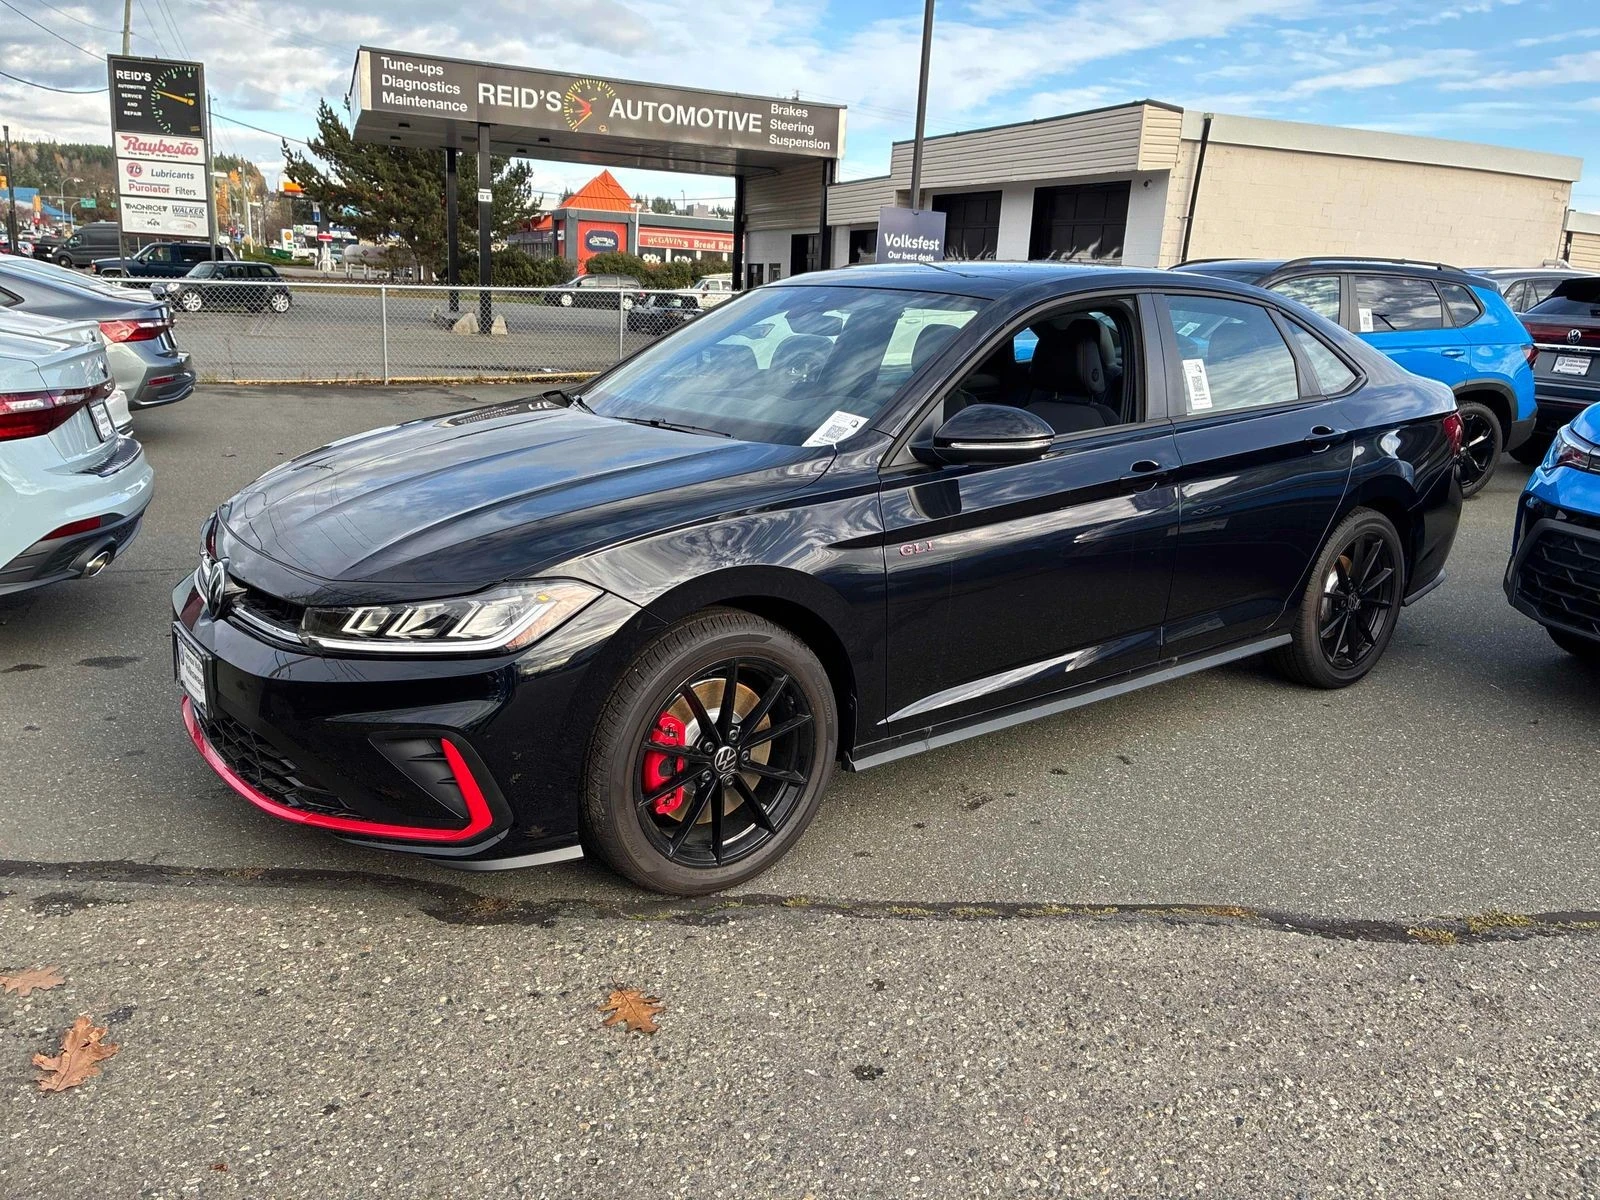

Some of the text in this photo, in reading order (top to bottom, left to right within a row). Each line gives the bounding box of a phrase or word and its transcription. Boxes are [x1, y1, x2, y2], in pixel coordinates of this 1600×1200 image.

[380, 56, 444, 76] Tune-ups
[116, 70, 152, 81] REID'S
[382, 74, 460, 94] Diagnostics
[382, 91, 468, 112] Maintenance
[478, 82, 762, 133] REID'S AUTOMOTIVE
[771, 104, 808, 118] Brakes
[770, 119, 814, 135] Steering
[121, 136, 199, 156] Raybestos
[769, 134, 830, 150] Suspension
[151, 169, 194, 179] Lubricants
[128, 183, 196, 196] Purolator Filters
[172, 206, 204, 216] WALKER
[694, 240, 716, 249] Bread
[884, 233, 939, 250] Volksfest
[888, 251, 901, 259] Our
[902, 252, 917, 260] best
[900, 540, 935, 556] GLI
